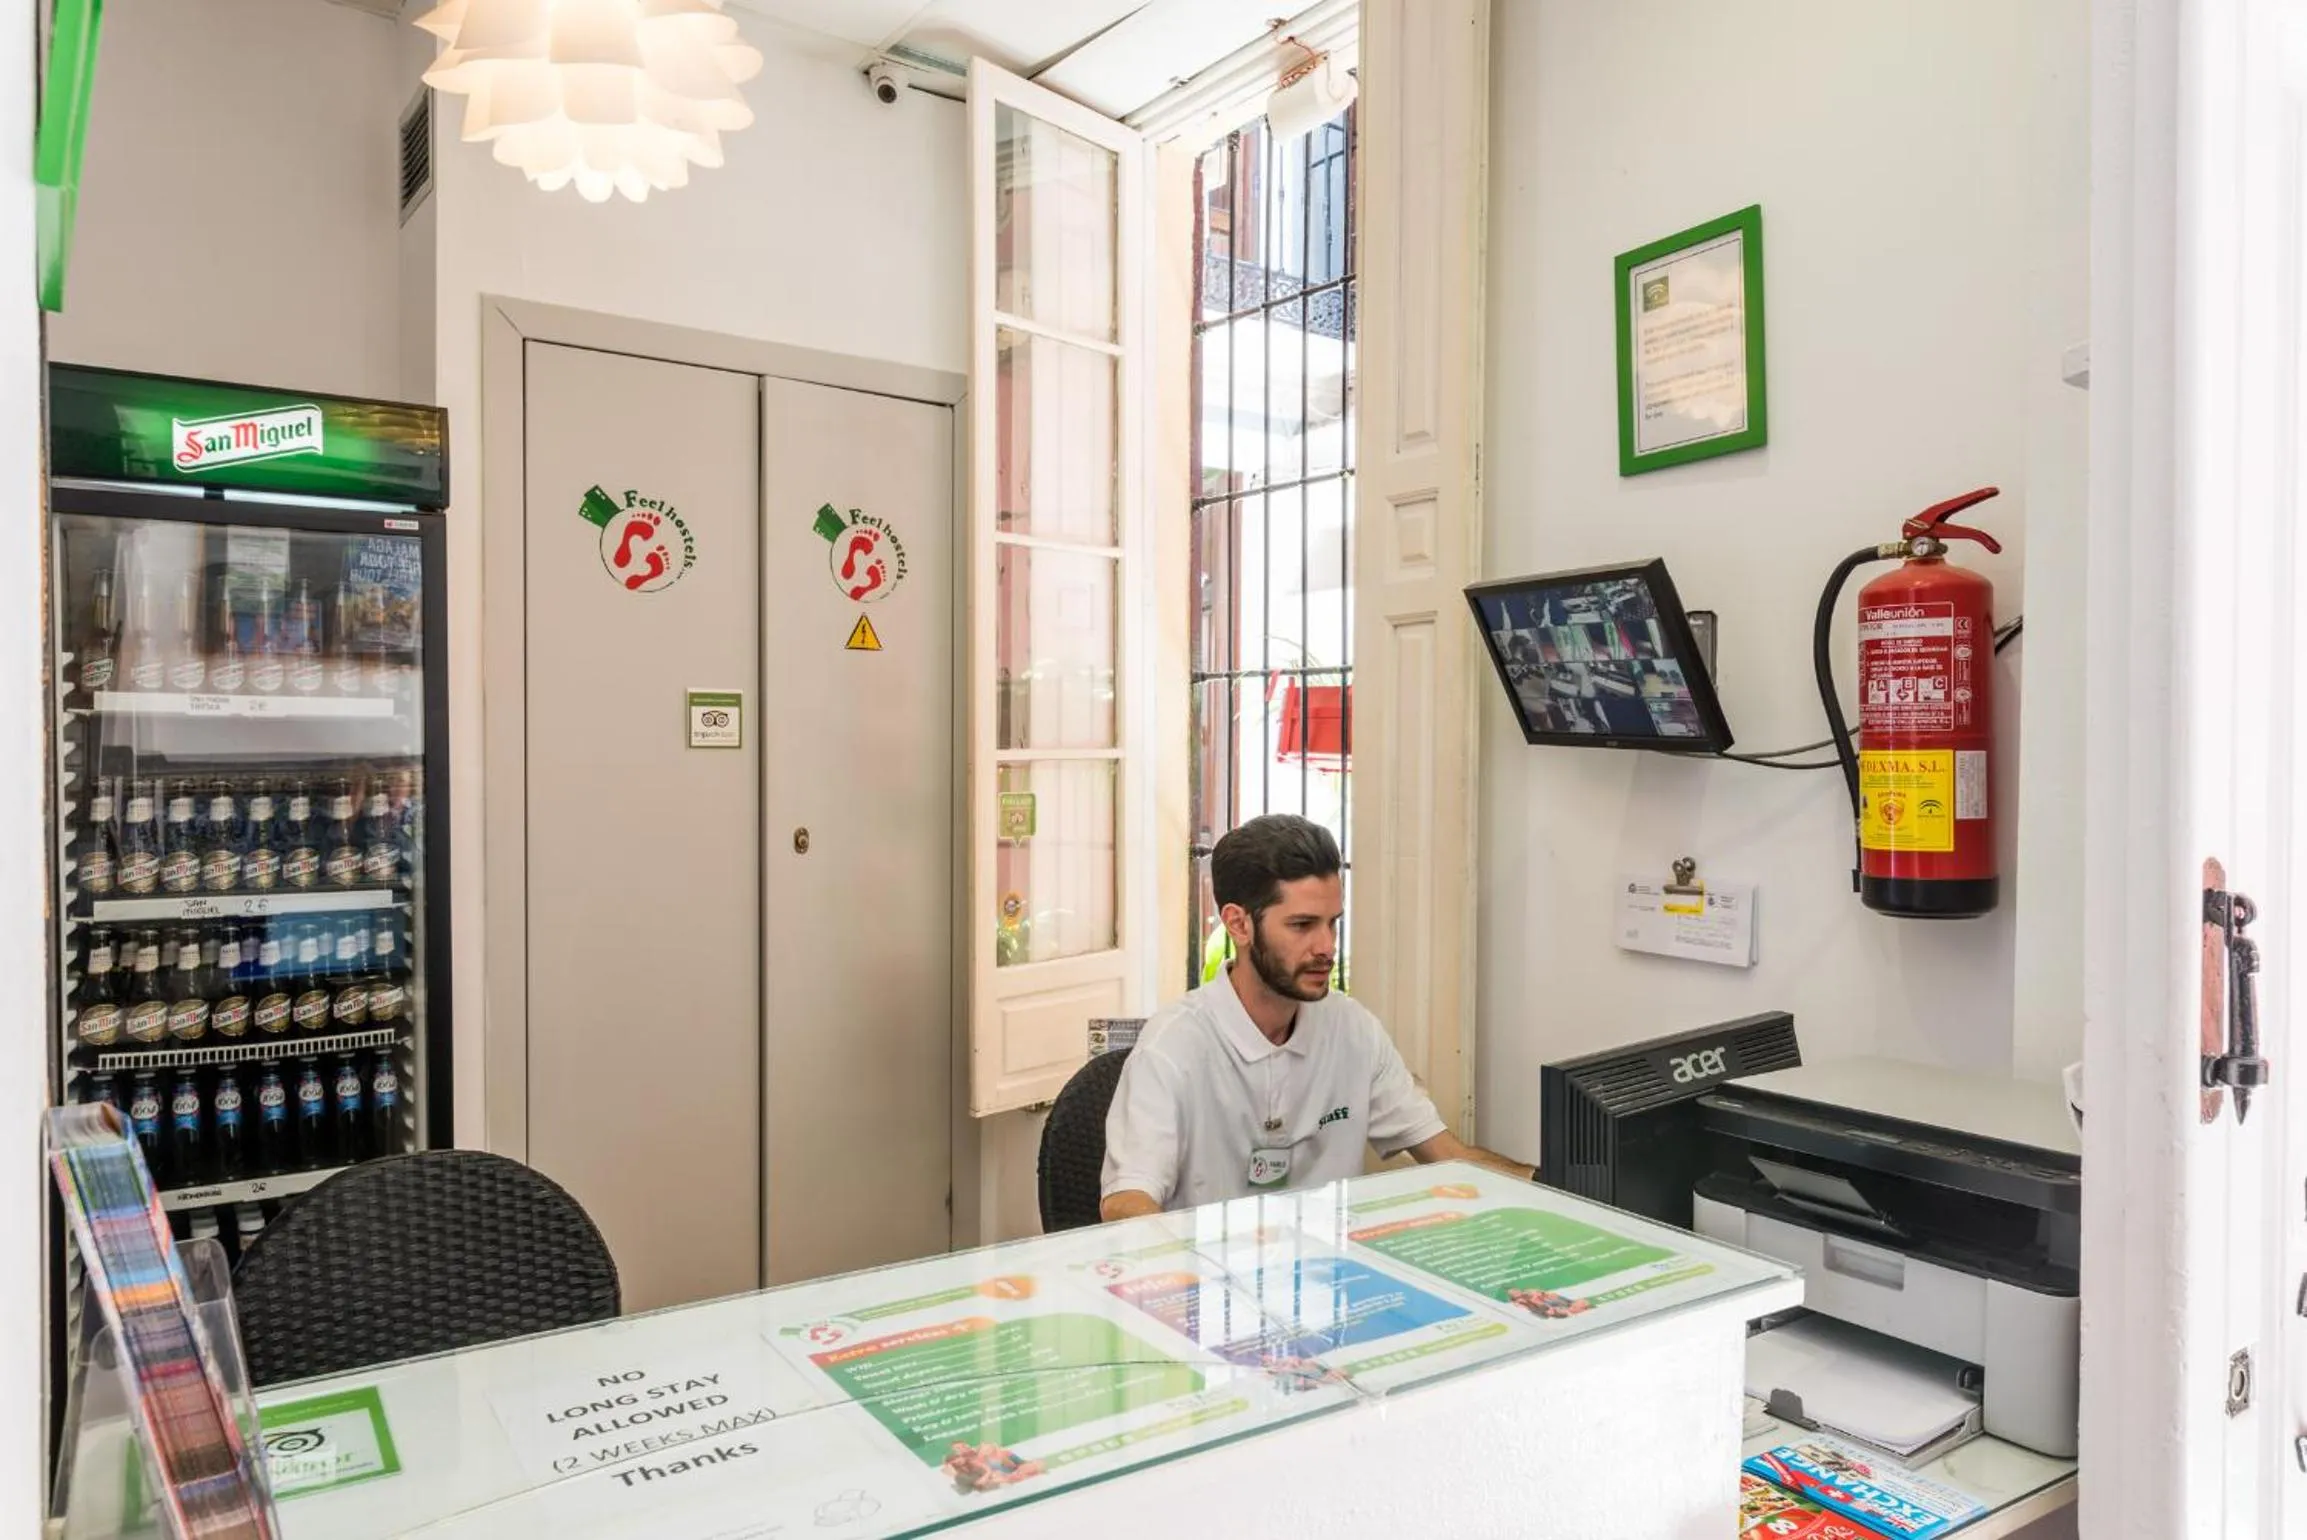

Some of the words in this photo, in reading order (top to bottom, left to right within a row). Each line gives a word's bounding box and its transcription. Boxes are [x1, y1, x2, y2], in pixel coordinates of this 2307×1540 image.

[177, 430, 231, 463] San
[230, 416, 312, 449] Miguel
[623, 490, 665, 511] Feel
[665, 507, 697, 569] hostels
[849, 508, 883, 529] Feel
[883, 524, 908, 580] hostels
[1905, 680, 1913, 689] B
[1934, 678, 1944, 689] C
[1669, 1046, 1726, 1083] acer
[547, 1393, 638, 1424] LONG
[646, 1374, 720, 1400] STAY
[597, 1369, 646, 1387] NO
[552, 1456, 579, 1474] (2
[590, 1428, 694, 1462] WEEKS
[700, 1406, 777, 1436] MAX)
[572, 1393, 729, 1441] ALLOWED
[611, 1441, 760, 1488] Thanks
